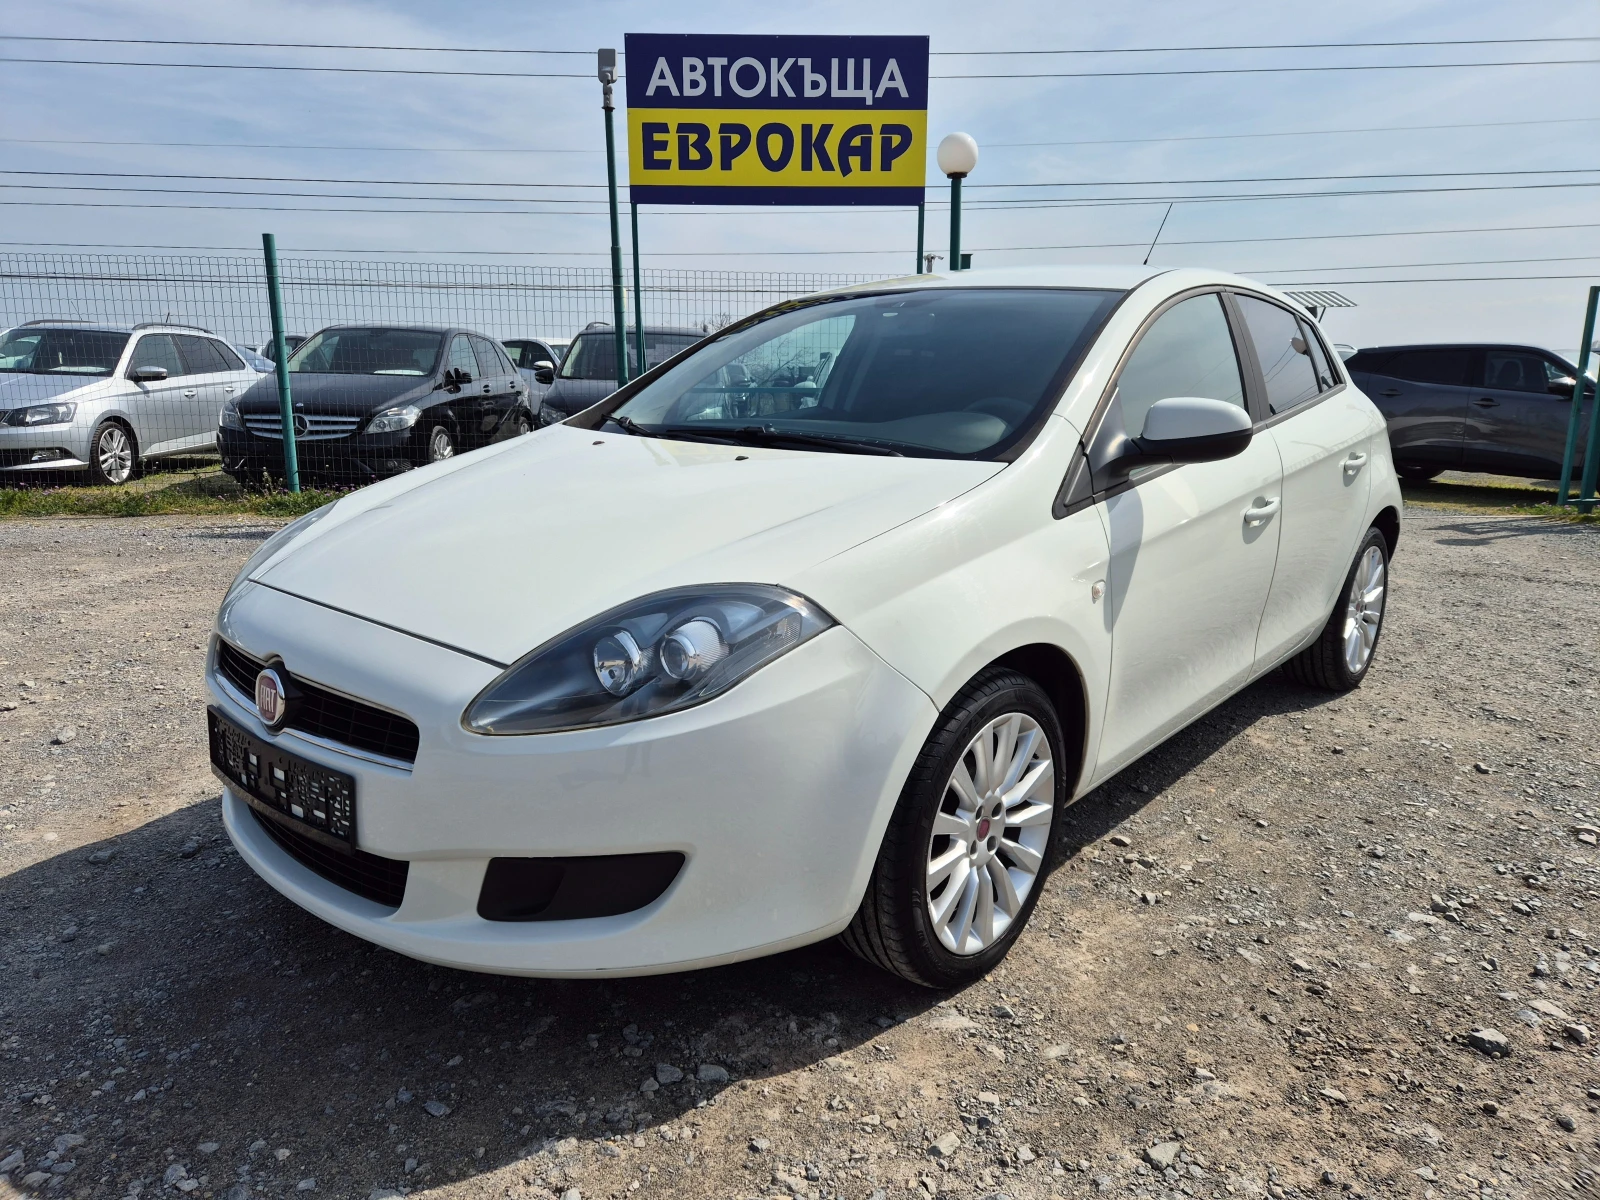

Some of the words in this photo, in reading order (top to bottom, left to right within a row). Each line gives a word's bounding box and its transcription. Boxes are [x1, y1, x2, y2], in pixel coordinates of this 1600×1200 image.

[645, 57, 909, 105] АВТОКЪЩА
[642, 122, 913, 178] ЕВРОКАР
[260, 685, 277, 713] FIAT
